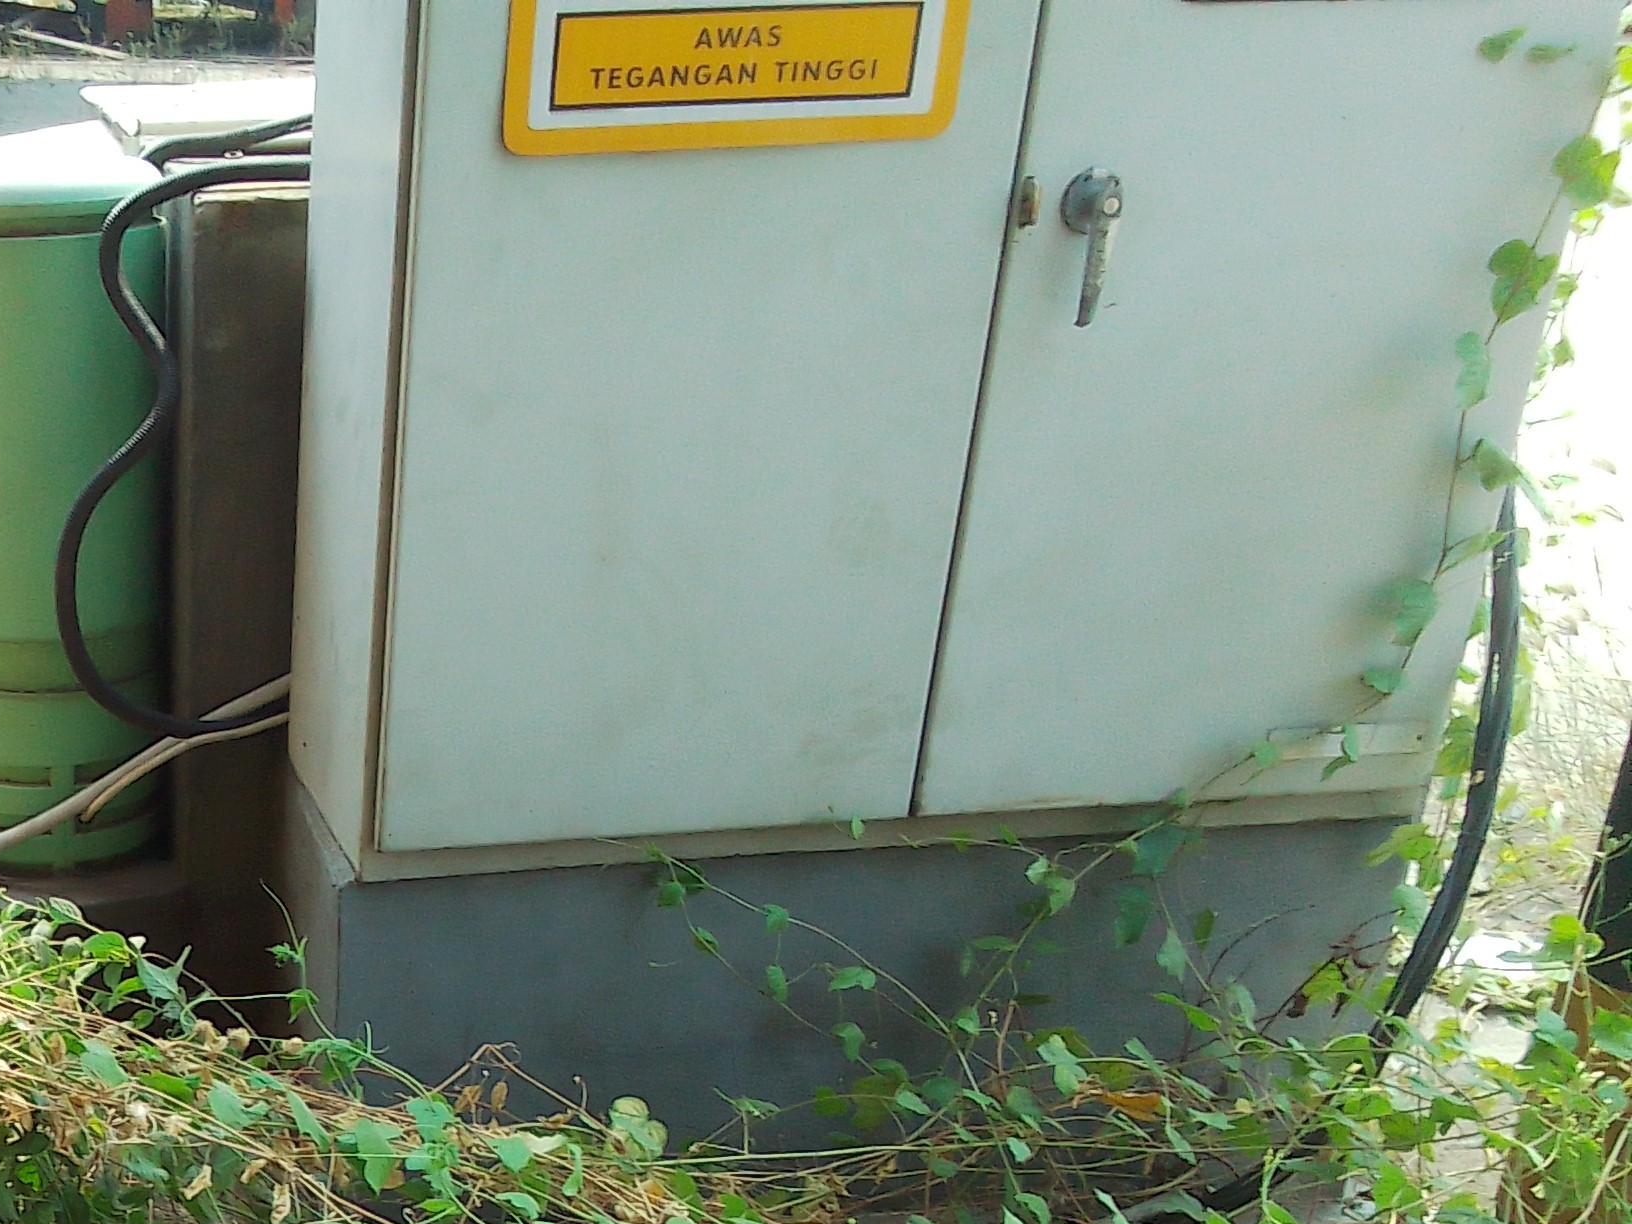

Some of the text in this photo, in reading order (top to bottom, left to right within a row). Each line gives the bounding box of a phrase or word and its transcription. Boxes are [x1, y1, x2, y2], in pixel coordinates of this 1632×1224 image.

[694, 25, 783, 50] AWAS
[590, 58, 878, 90] TEGANGAN TINGGI
